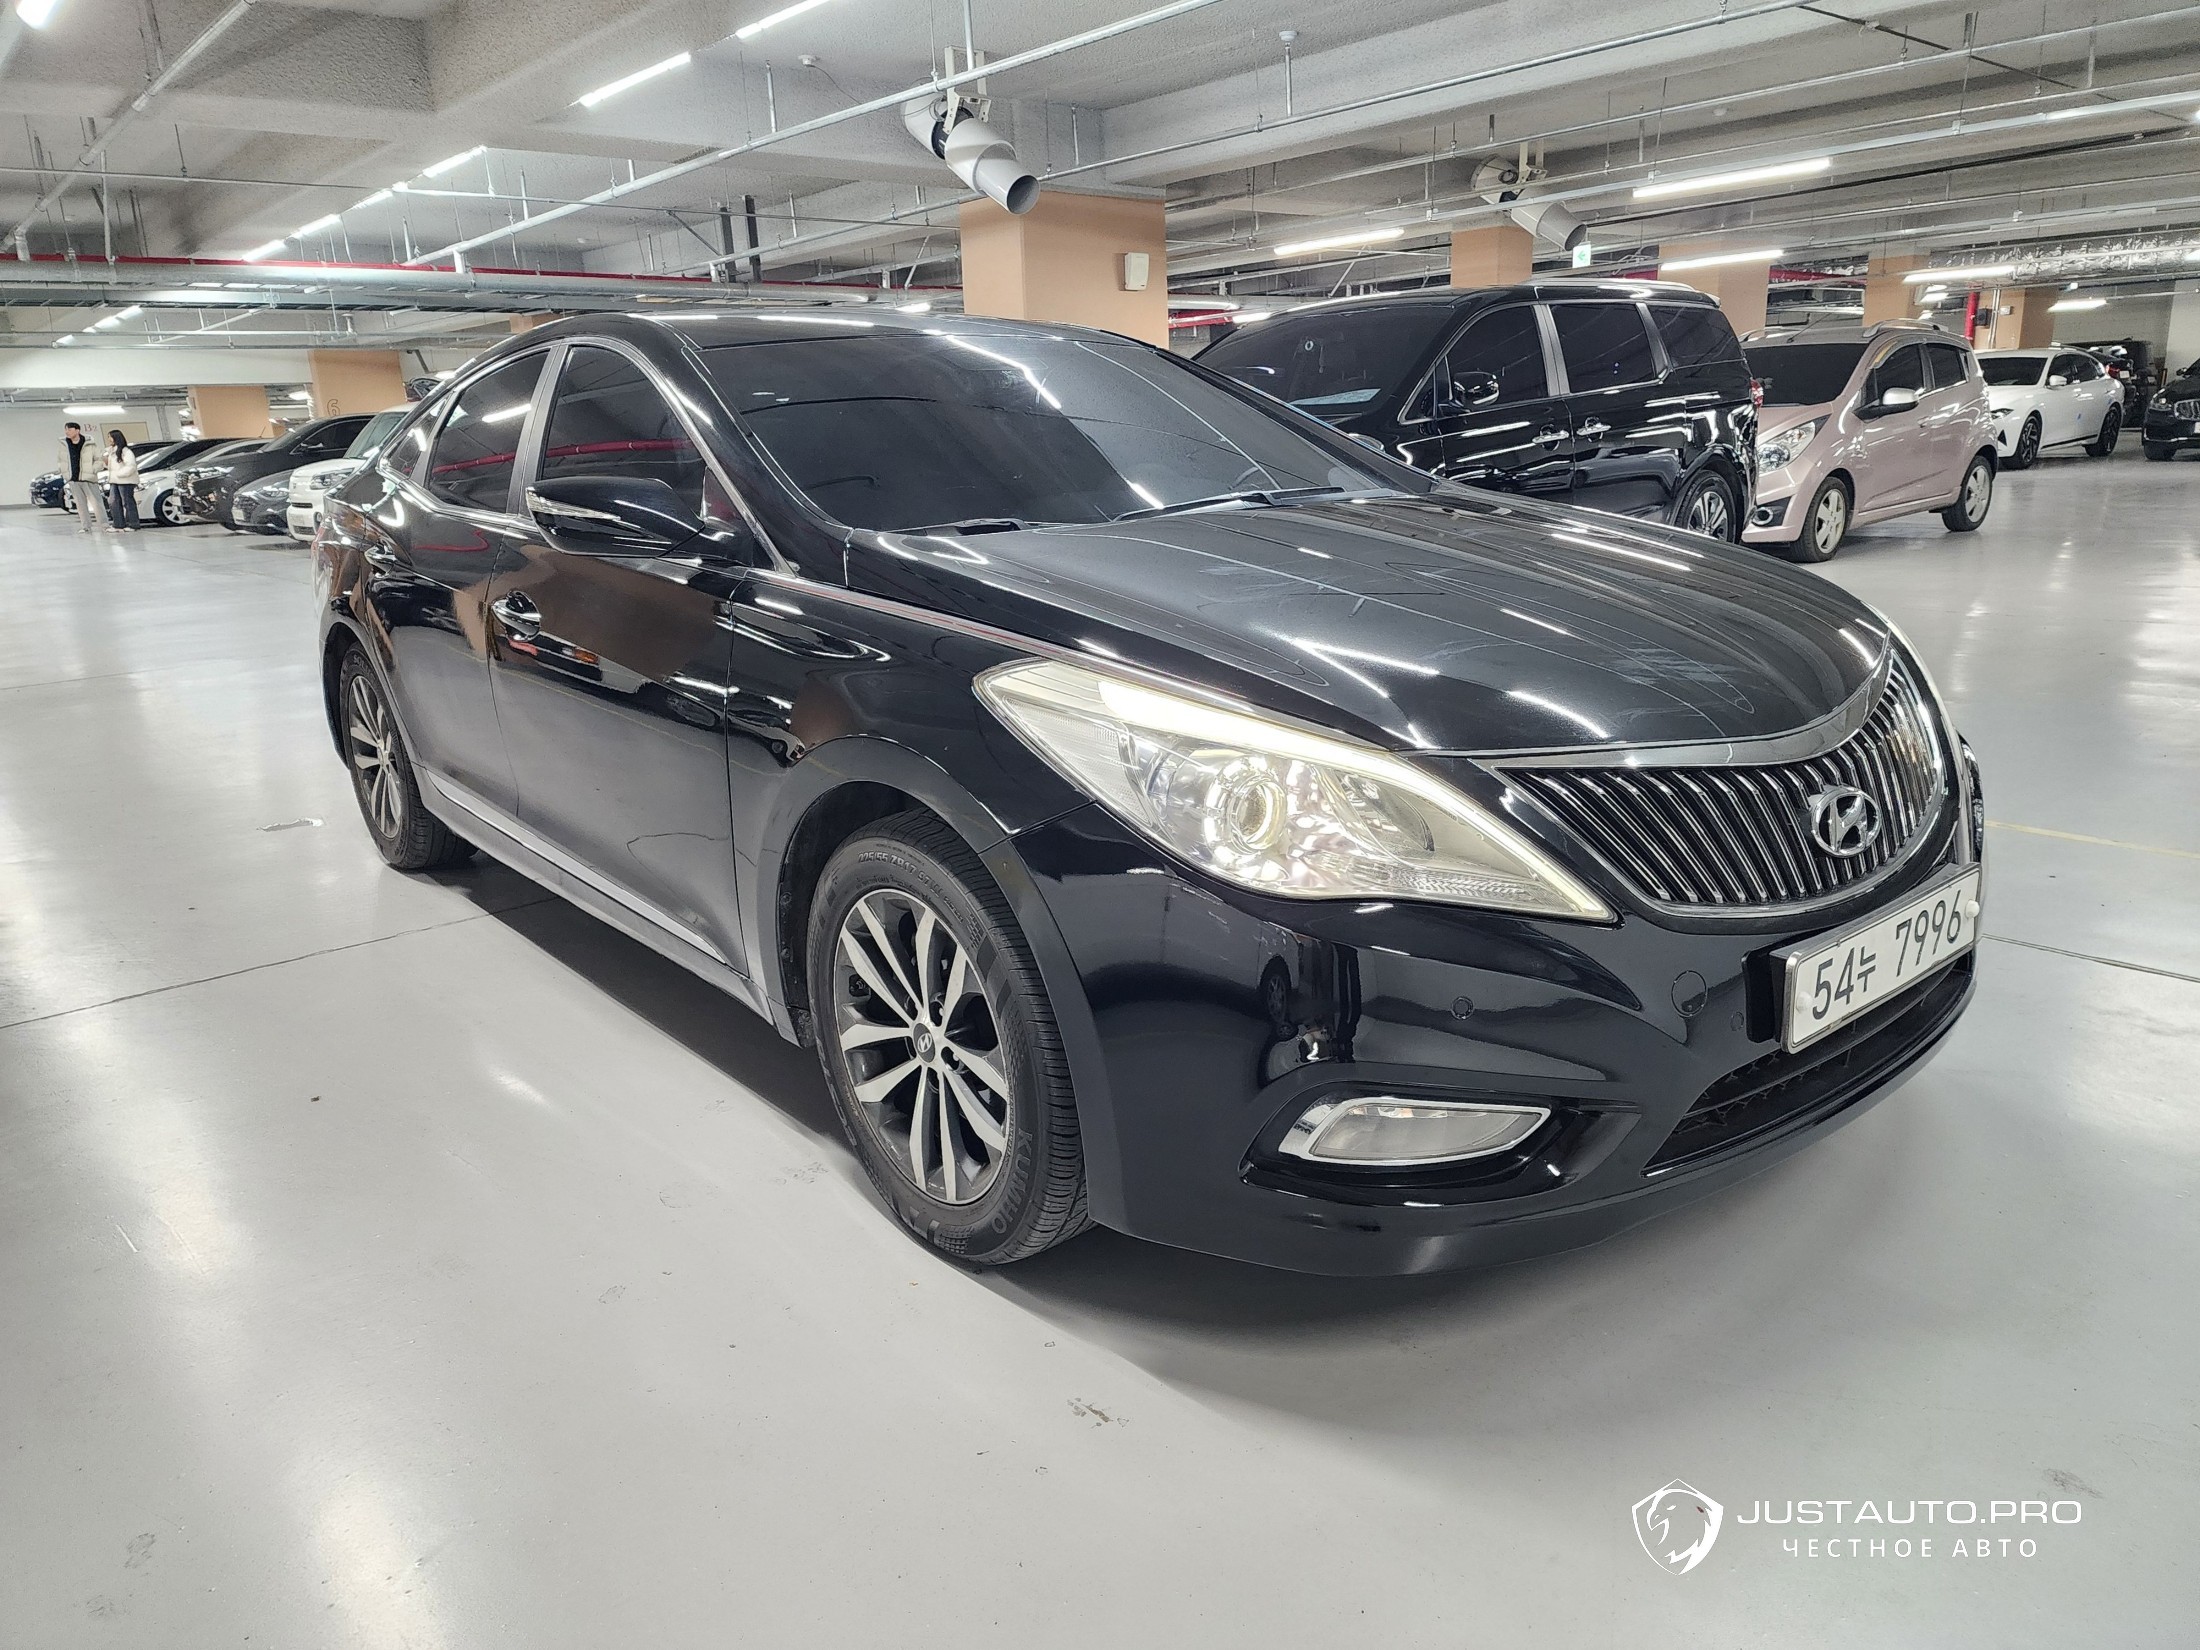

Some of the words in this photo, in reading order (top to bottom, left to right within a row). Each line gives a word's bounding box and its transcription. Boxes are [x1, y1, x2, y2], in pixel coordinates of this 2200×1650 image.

[1812, 946, 1877, 1020] 54누
[1896, 889, 1962, 978] 7996
[992, 1127, 1033, 1234] KUMHO
